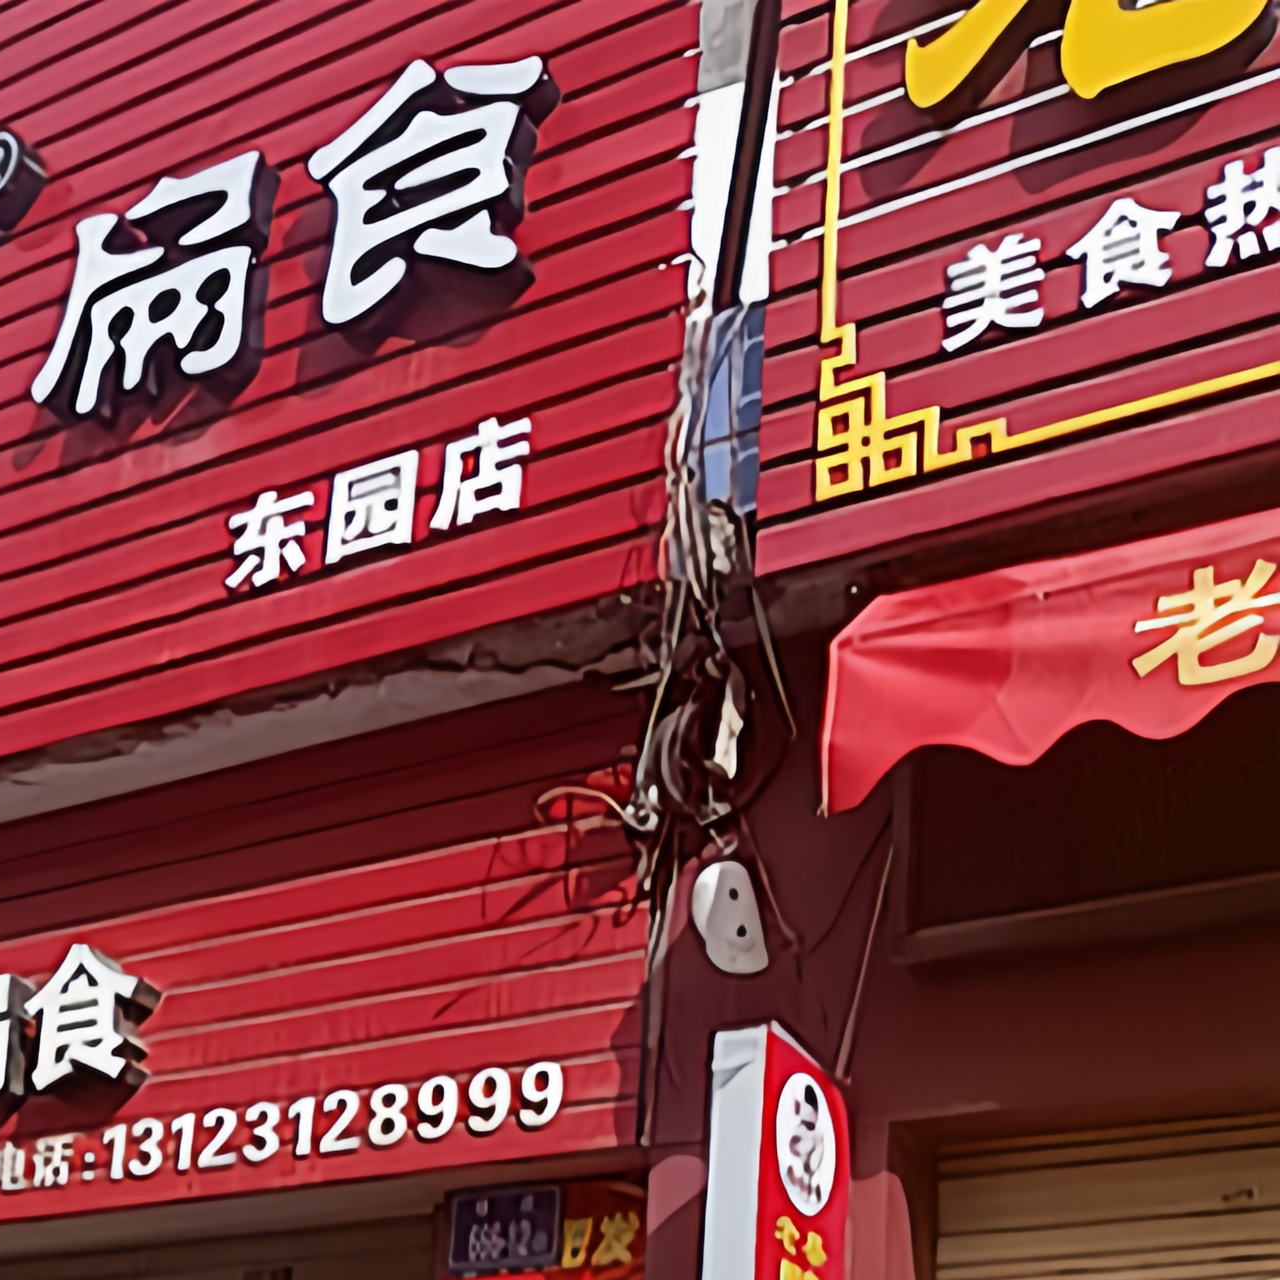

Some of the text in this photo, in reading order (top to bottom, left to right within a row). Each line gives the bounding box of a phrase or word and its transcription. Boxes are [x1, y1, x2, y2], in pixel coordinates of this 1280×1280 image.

[31, 56, 542, 414] 扁食
[226, 417, 532, 590] 东园店
[1132, 558, 1280, 685] 老
